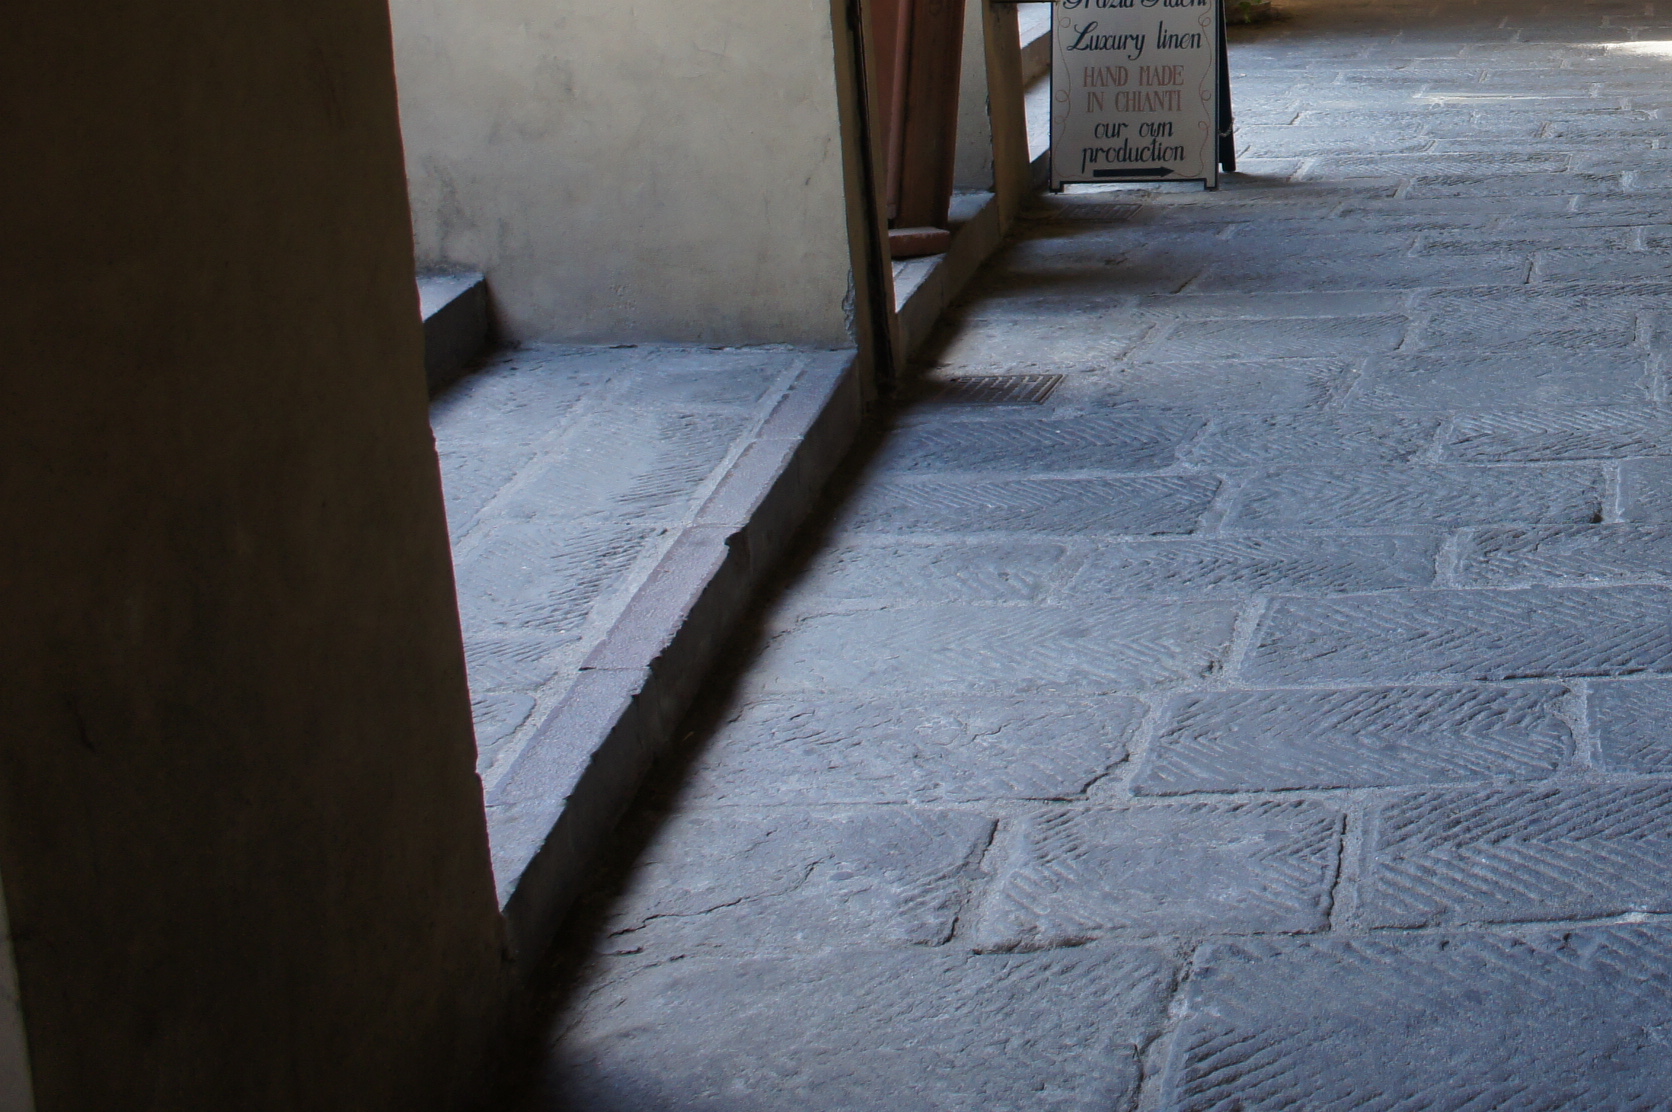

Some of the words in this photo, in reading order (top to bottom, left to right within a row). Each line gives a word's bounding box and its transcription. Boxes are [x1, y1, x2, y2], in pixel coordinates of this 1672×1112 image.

[1067, 21, 1146, 61] Luxury
[1156, 20, 1203, 50] linen
[1083, 65, 1128, 88] HAND
[1139, 65, 1185, 87] MADE
[1087, 91, 1104, 113] IN
[1115, 90, 1182, 112] CHIANTI
[1094, 122, 1128, 139] our
[1139, 120, 1174, 139] own
[1081, 139, 1185, 175] production
